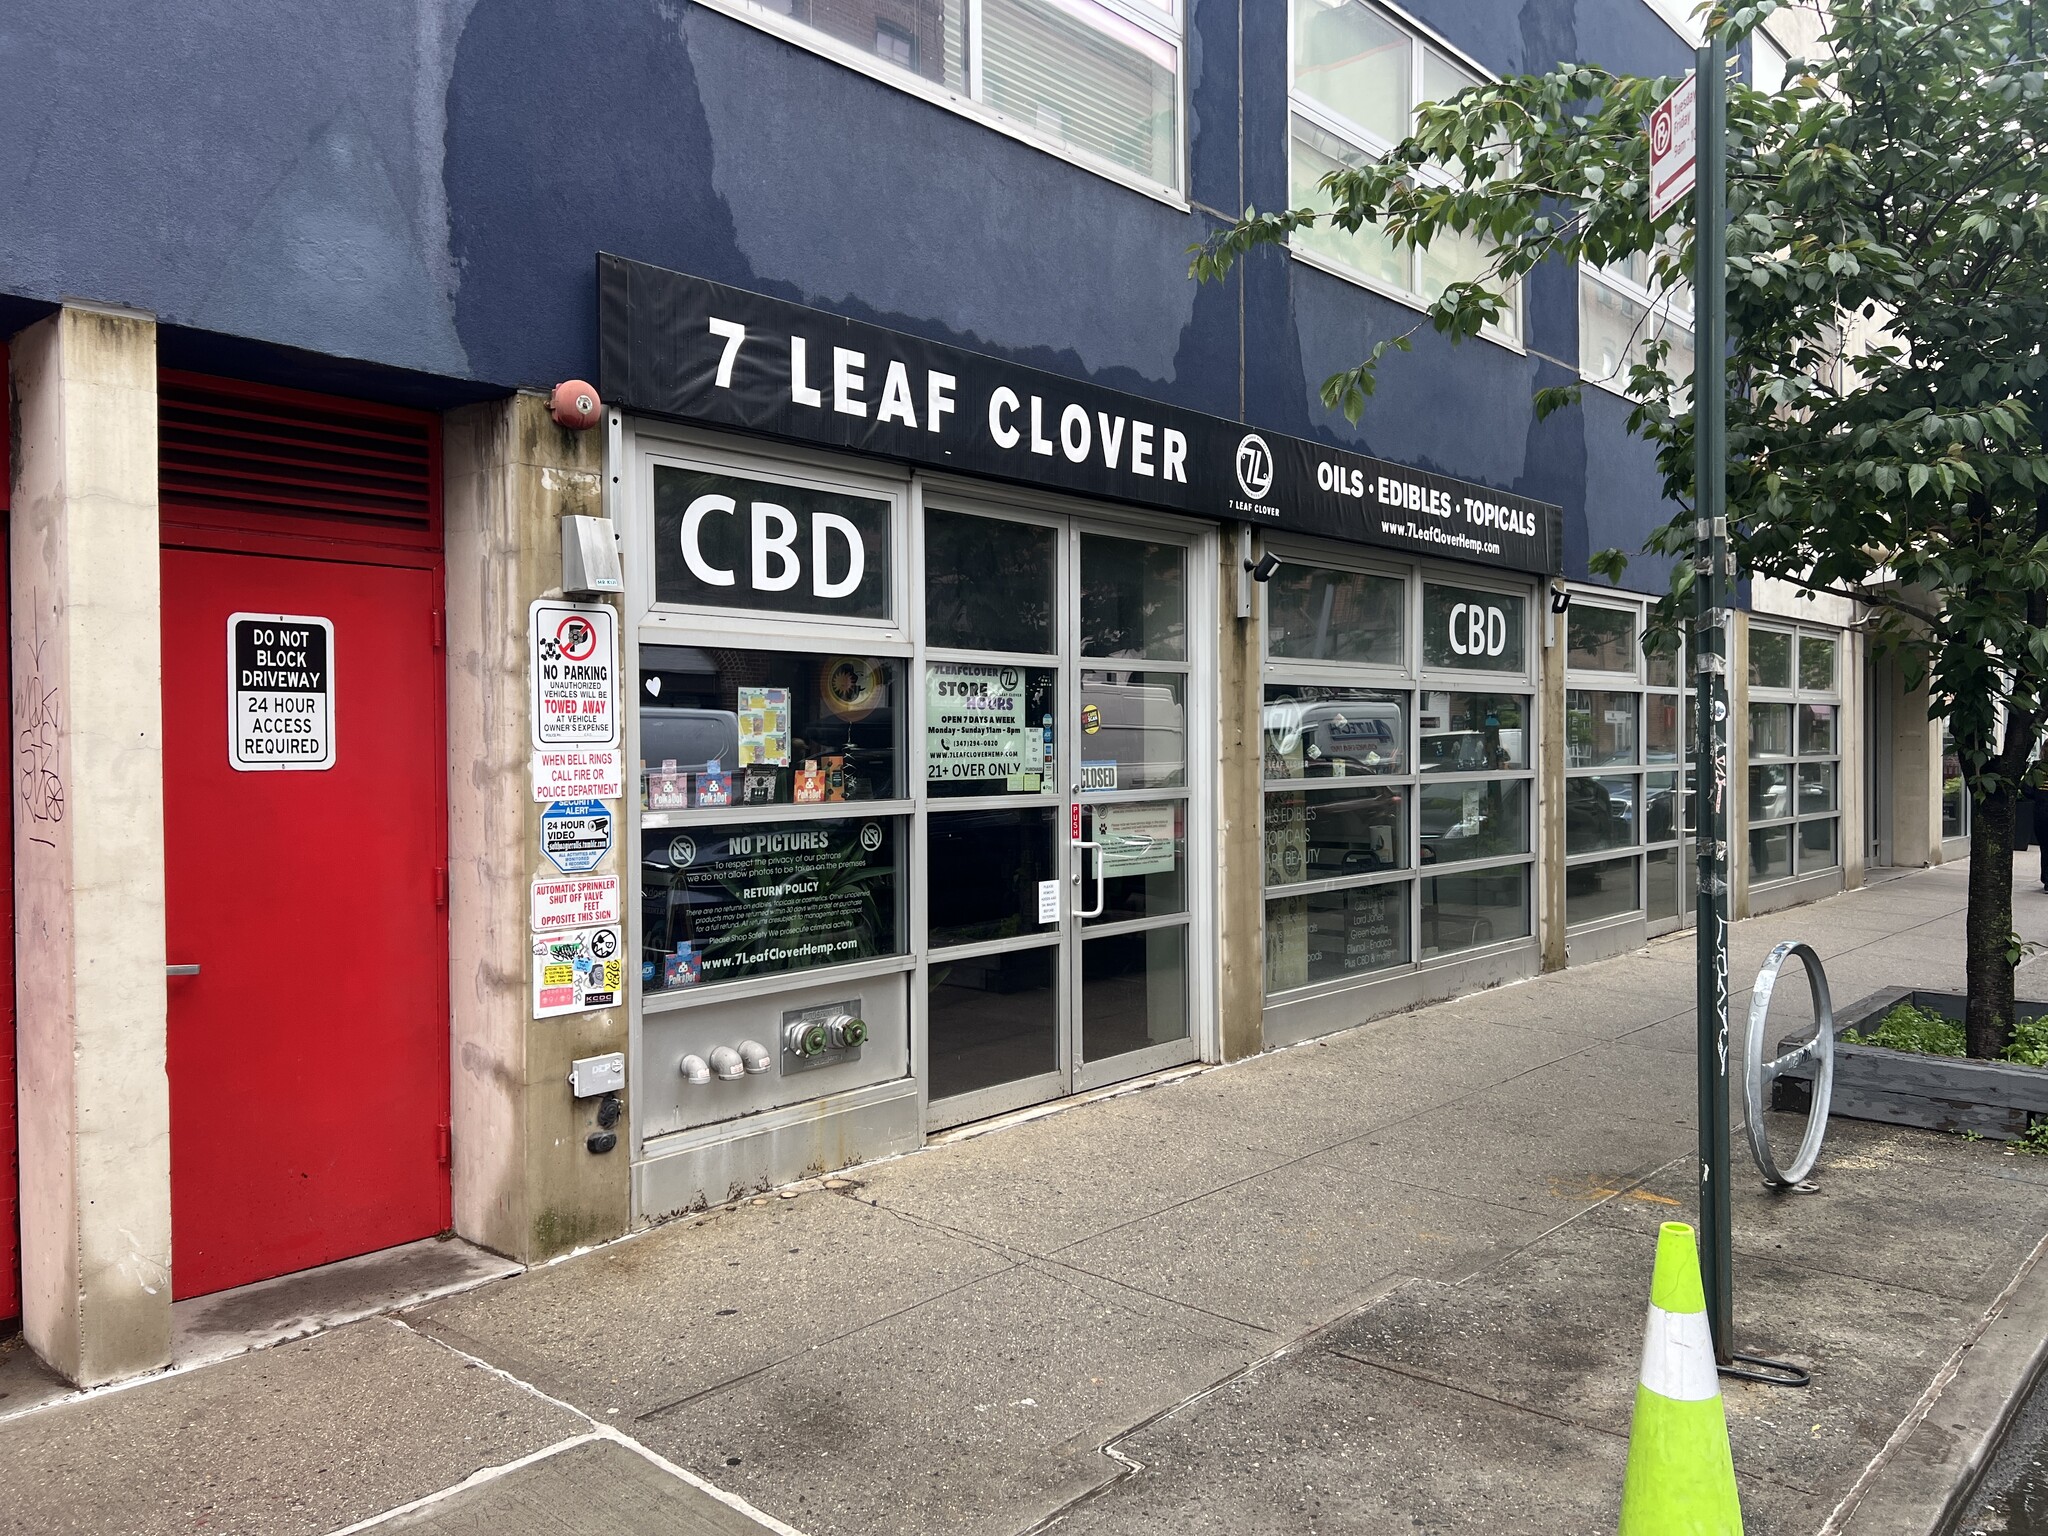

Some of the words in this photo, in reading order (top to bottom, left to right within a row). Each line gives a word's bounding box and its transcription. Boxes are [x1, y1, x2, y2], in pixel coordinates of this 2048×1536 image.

[1674, 111, 1691, 135] Friday
[708, 316, 746, 388] 7
[790, 335, 957, 433] LEAF
[988, 386, 1188, 484] CLOVER
[1317, 461, 1364, 498] OILS
[1378, 476, 1452, 518] EDIBLES
[1463, 498, 1536, 537] TOPICALS
[1229, 500, 1233, 509] 7
[1235, 501, 1252, 512] LEAF
[1254, 504, 1280, 517] CLOVER
[1381, 520, 1500, 555] www.7LeafCloverHemp.com
[680, 493, 865, 599] CBD
[1449, 602, 1506, 657] CBD
[253, 629, 275, 646] DO
[279, 630, 309, 647] NOT
[256, 650, 307, 667] BLOCK
[543, 664, 558, 680] NO
[564, 665, 607, 681] PARKING
[934, 665, 998, 677] 7LEAFCLOVER
[242, 670, 320, 688] DRIVEWAY
[550, 681, 601, 690] UNAUTHORIZED
[544, 690, 578, 698] VEHICLES
[938, 681, 988, 697] STORE
[248, 697, 268, 713] 24
[274, 697, 315, 713] HOUR
[544, 699, 577, 714] TOWED
[582, 700, 606, 714] AWAY
[966, 696, 1014, 710] HOURS
[252, 718, 312, 733] ACCESS
[556, 715, 565, 723] AT
[567, 715, 597, 723] VEHICLE
[941, 715, 962, 724] OPEN
[963, 716, 968, 724] 7
[969, 716, 988, 724] DAYS
[989, 716, 995, 724] A
[995, 716, 1016, 724] WEEK
[544, 723, 577, 732] OWNER'S
[577, 723, 609, 732] EXPENSE
[928, 726, 956, 736] Monday
[961, 726, 985, 736] Sunday
[985, 726, 1002, 734] 11am
[1006, 726, 1021, 736] 8pm
[245, 738, 319, 754] REQUIRED
[542, 754, 565, 766] WHEN
[568, 754, 587, 765] BELL
[589, 753, 612, 764] RINGS
[929, 751, 1018, 759] WWW.7LEAFCLOVERHEMP.COM
[551, 770, 572, 782] CALL
[574, 769, 591, 780] FIRE
[593, 769, 604, 780] OR
[928, 764, 949, 778] 21+
[952, 763, 985, 777] OVER
[988, 763, 1021, 776] ONLY
[1081, 767, 1115, 789] CLOSED
[537, 785, 566, 798] POLICE
[568, 783, 618, 796] DEPARTMENT
[565, 806, 590, 815] ALERT
[1265, 808, 1279, 823] ILS
[1281, 806, 1317, 823] EDIBLES
[547, 821, 558, 830] 24
[560, 820, 585, 829] HOUR
[547, 831, 575, 840] VIDEO
[729, 836, 751, 855] NO
[756, 831, 829, 853] PICTURES
[1265, 827, 1311, 846] TOPICALS
[715, 861, 724, 869] To
[725, 859, 753, 870] respect
[754, 858, 767, 866] the
[768, 855, 793, 866] privacy
[795, 854, 803, 862] of
[816, 852, 842, 861] patrons
[1285, 848, 1321, 866] BEAUTY
[701, 873, 712, 881] do
[713, 871, 727, 880] not
[728, 870, 748, 879] allow
[749, 868, 774, 878] photos
[774, 866, 783, 874] to
[795, 864, 814, 872] taken
[536, 883, 576, 895] AUTOMATIC
[577, 880, 615, 892] SPRINKLER
[743, 885, 782, 899] RETURN
[785, 881, 819, 894] POLICY
[549, 894, 567, 905] SHUT
[569, 893, 582, 902] OFF
[583, 891, 603, 901] VALVE
[583, 901, 600, 911] FEET
[686, 908, 702, 916] There
[541, 913, 576, 926] OPPOSITE
[578, 912, 593, 922] THIS
[595, 910, 611, 920] SIGN
[695, 916, 722, 925] products
[722, 914, 735, 922] may
[794, 905, 806, 913] days
[804, 909, 840, 919] management
[1353, 914, 1366, 925] Lord
[1367, 912, 1385, 923] Jones
[709, 936, 730, 945] Please
[731, 933, 747, 943] Shop
[779, 926, 809, 936] prosecute
[810, 922, 832, 931] criminal
[1350, 928, 1369, 940] Green
[702, 938, 858, 970] www.7LeafCloverHemp.com
[1344, 958, 1356, 968] Plus
[1356, 955, 1370, 966] CBD
